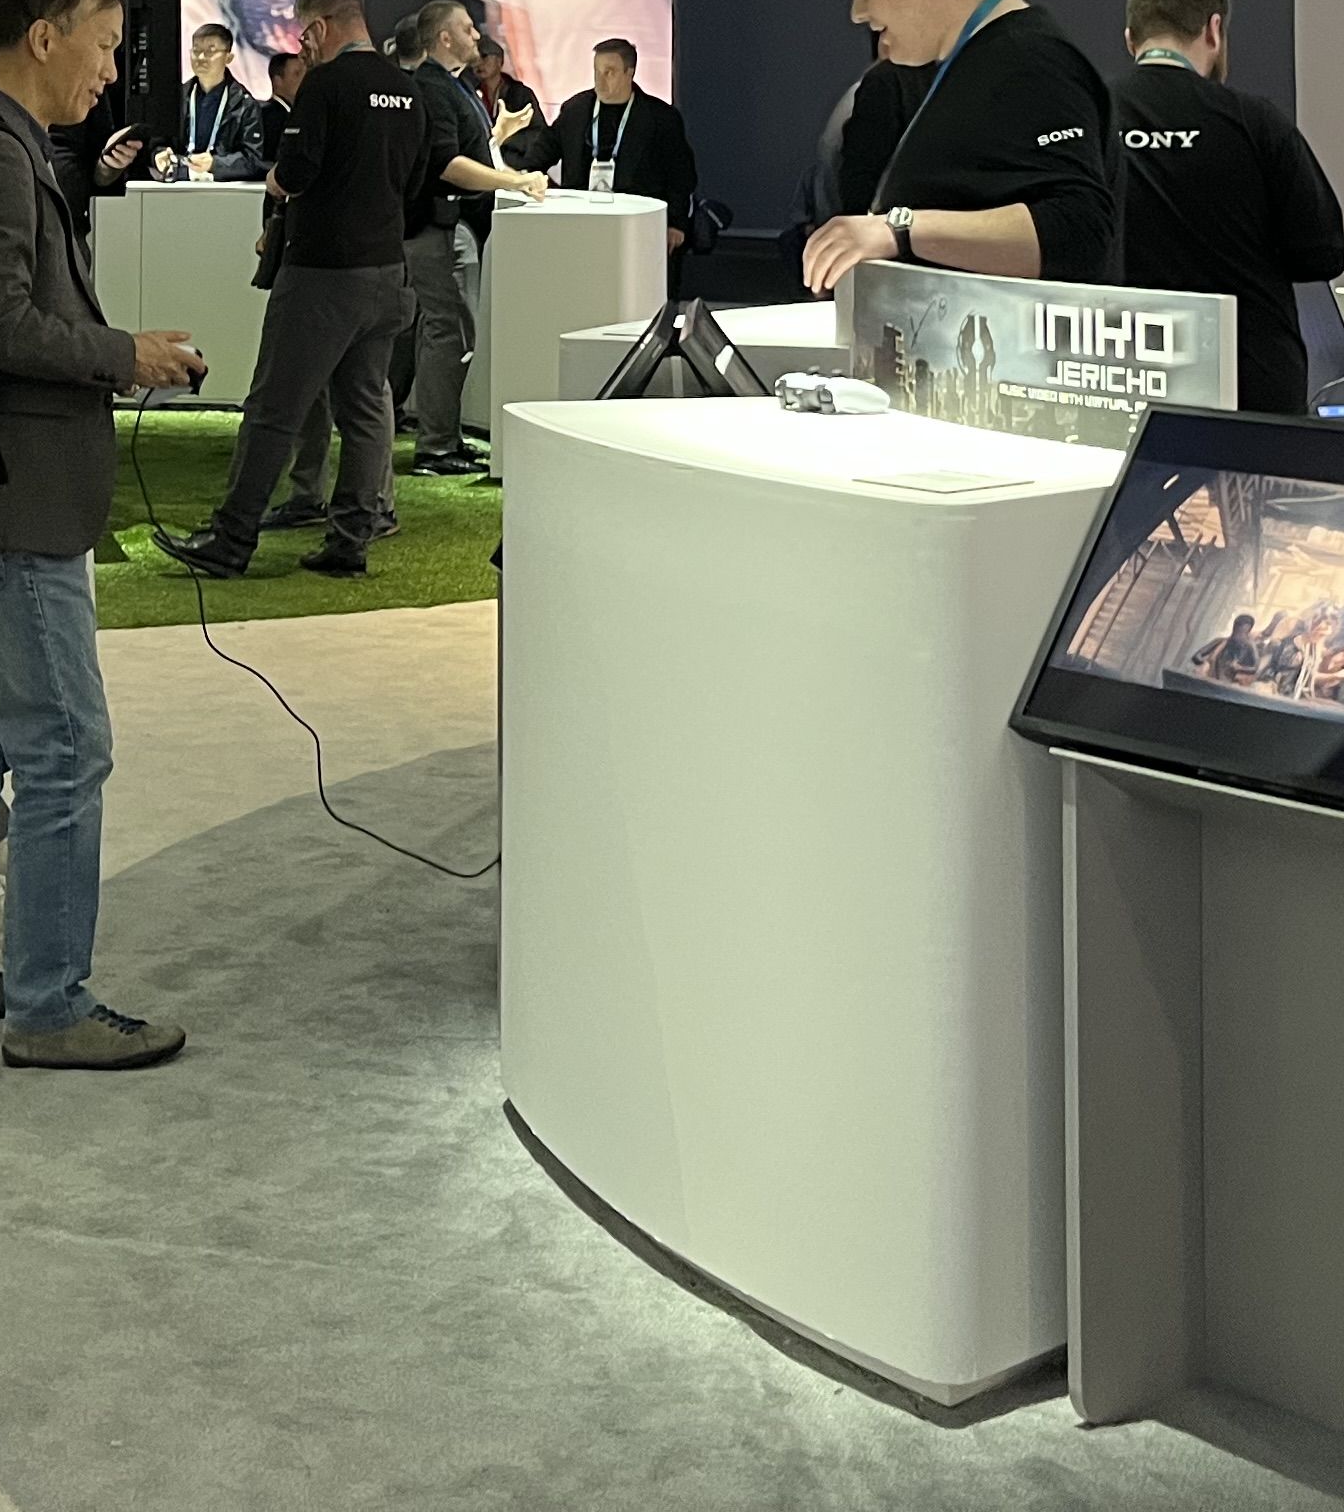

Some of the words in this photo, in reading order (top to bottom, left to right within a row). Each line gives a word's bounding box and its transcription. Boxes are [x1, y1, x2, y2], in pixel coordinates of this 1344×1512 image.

[369, 93, 413, 110] SONY
[1037, 128, 1084, 147] SONY
[1119, 129, 1200, 149] ONY
[1035, 302, 1173, 363] INIKO
[1046, 360, 1167, 398] JERICHO
[1084, 395, 1133, 412] VIRTUAL
